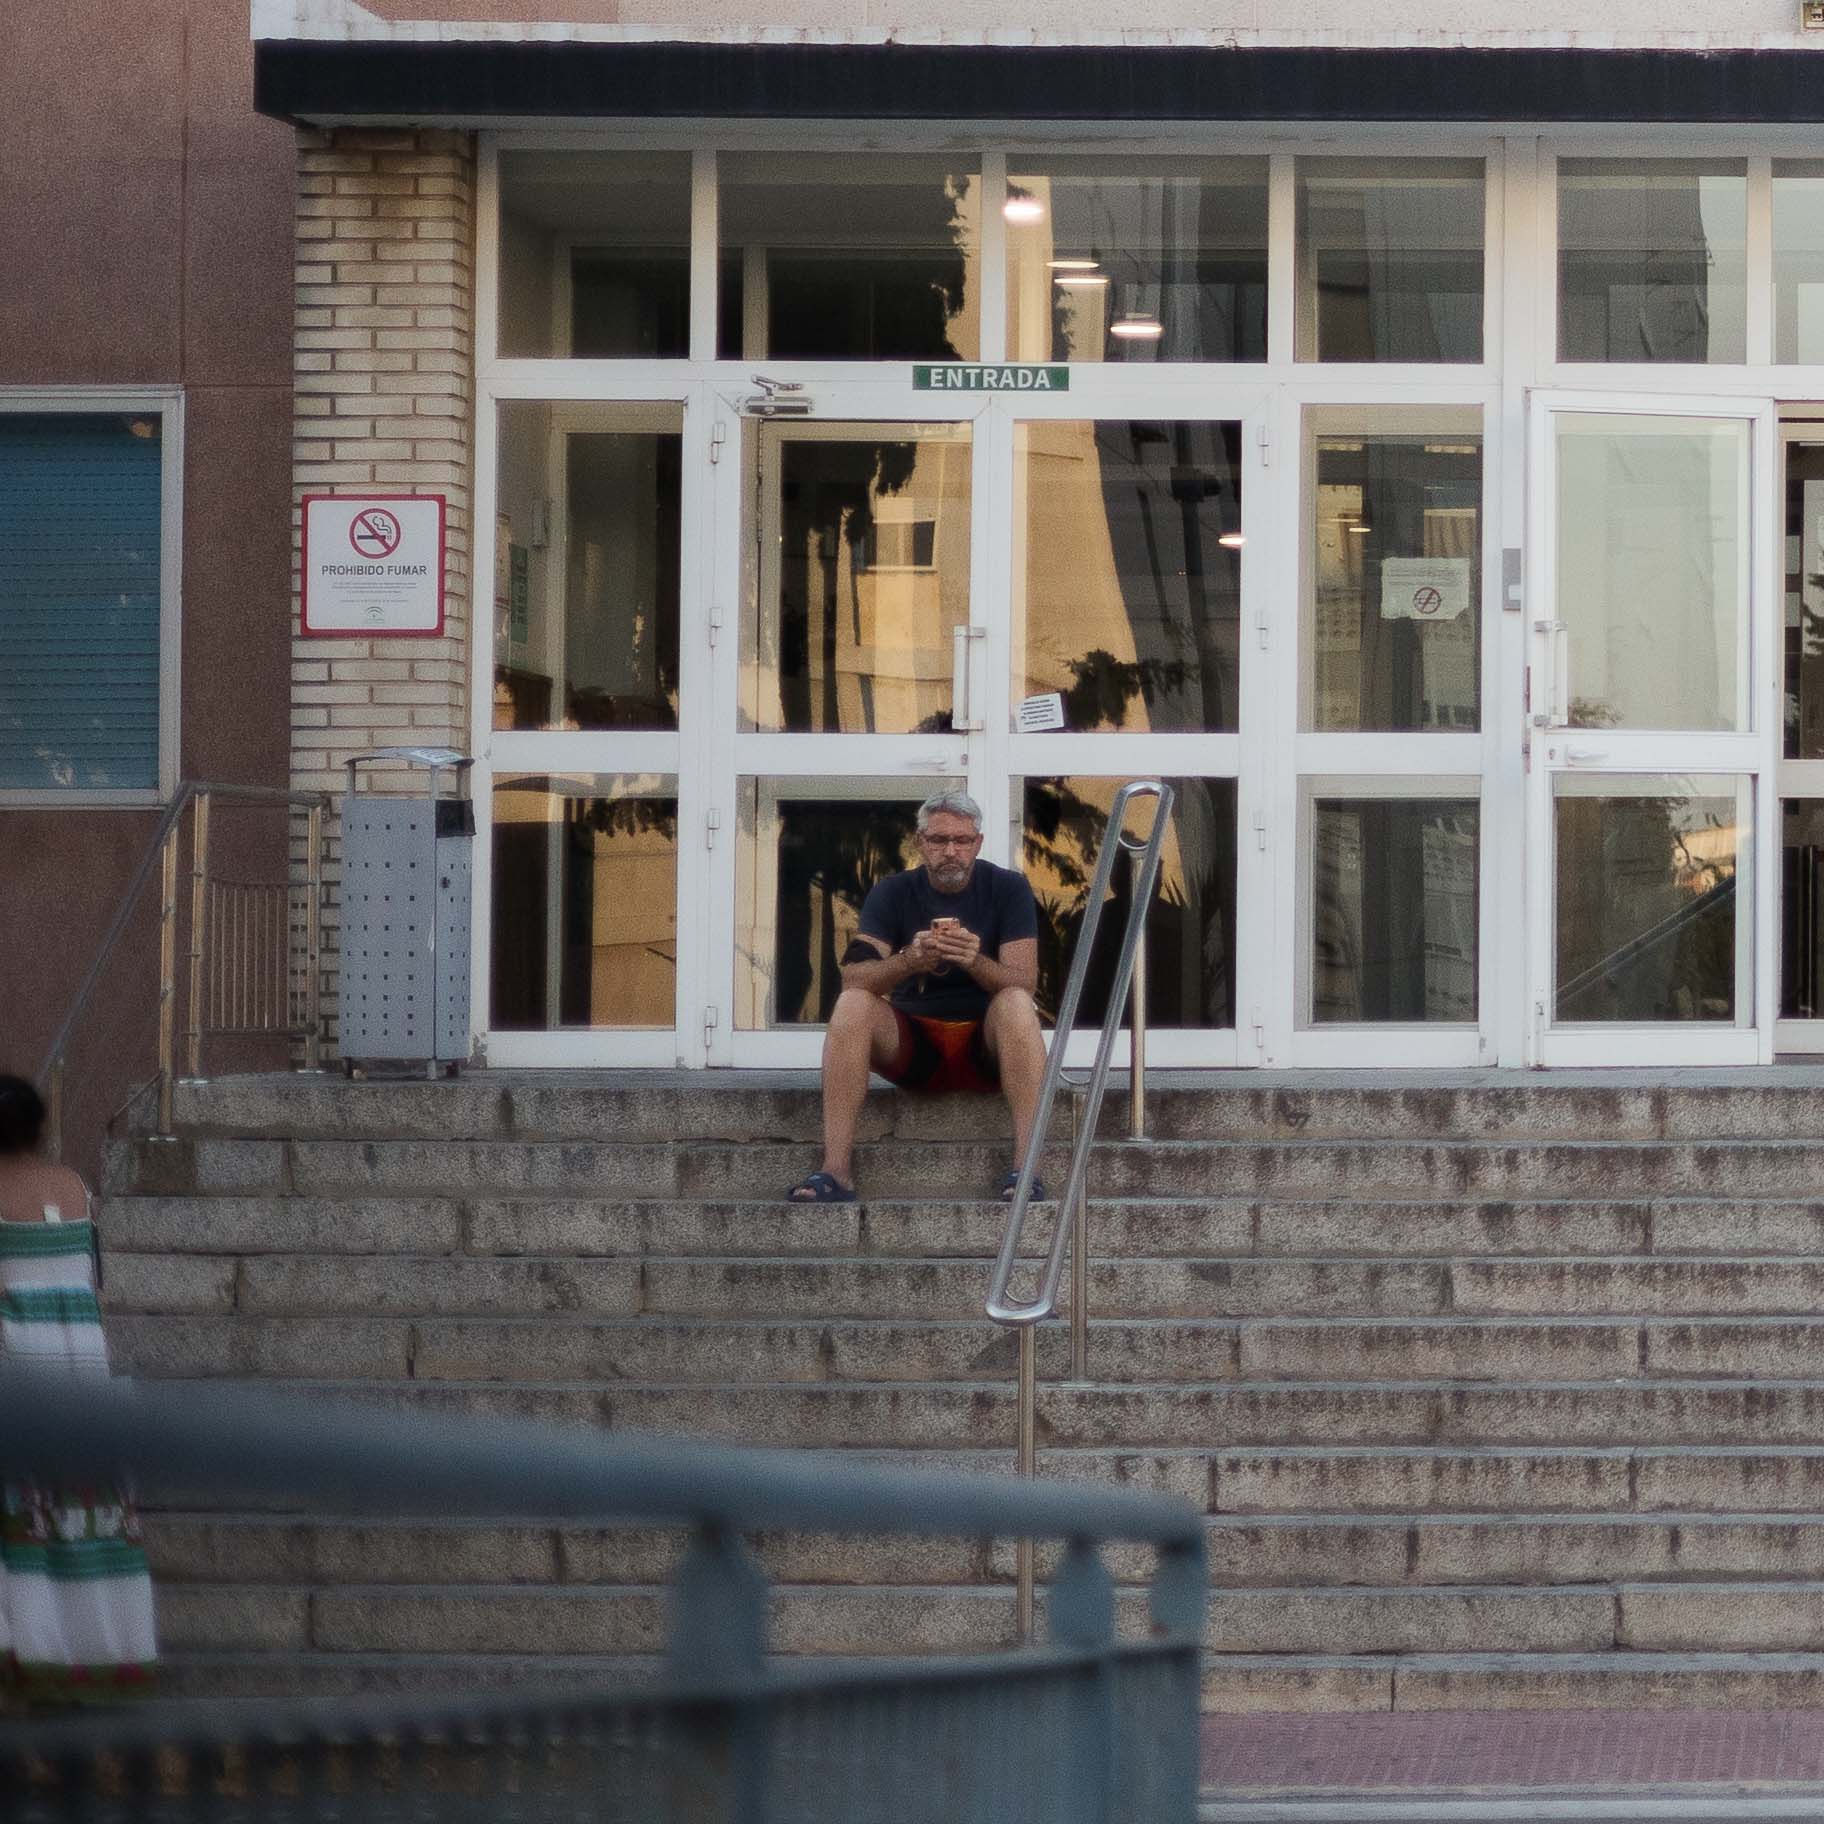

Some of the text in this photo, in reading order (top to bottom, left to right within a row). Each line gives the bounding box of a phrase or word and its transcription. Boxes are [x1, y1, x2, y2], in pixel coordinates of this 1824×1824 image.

[930, 368, 1050, 388] ENTRADA
[321, 565, 428, 576] PROHIBIDO FUMAR
